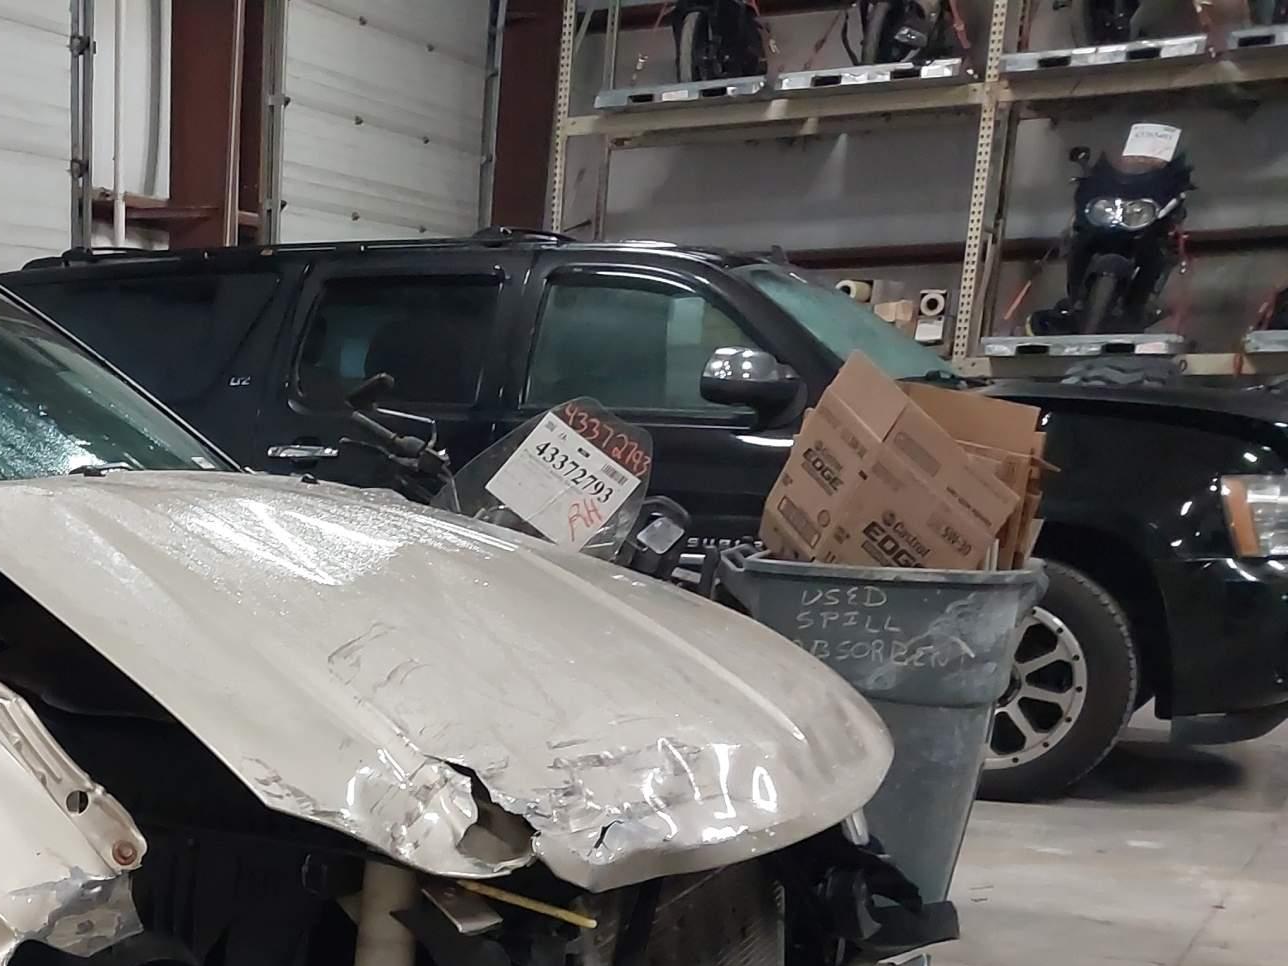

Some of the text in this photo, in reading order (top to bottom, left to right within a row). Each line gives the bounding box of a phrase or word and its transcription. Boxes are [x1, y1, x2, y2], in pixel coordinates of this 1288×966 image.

[565, 403, 651, 477] 43372793
[535, 441, 614, 503] 43372793
[803, 448, 843, 491] EDGE
[862, 521, 927, 568] EDG
[800, 586, 888, 607] USED
[795, 611, 902, 633] SPILL
